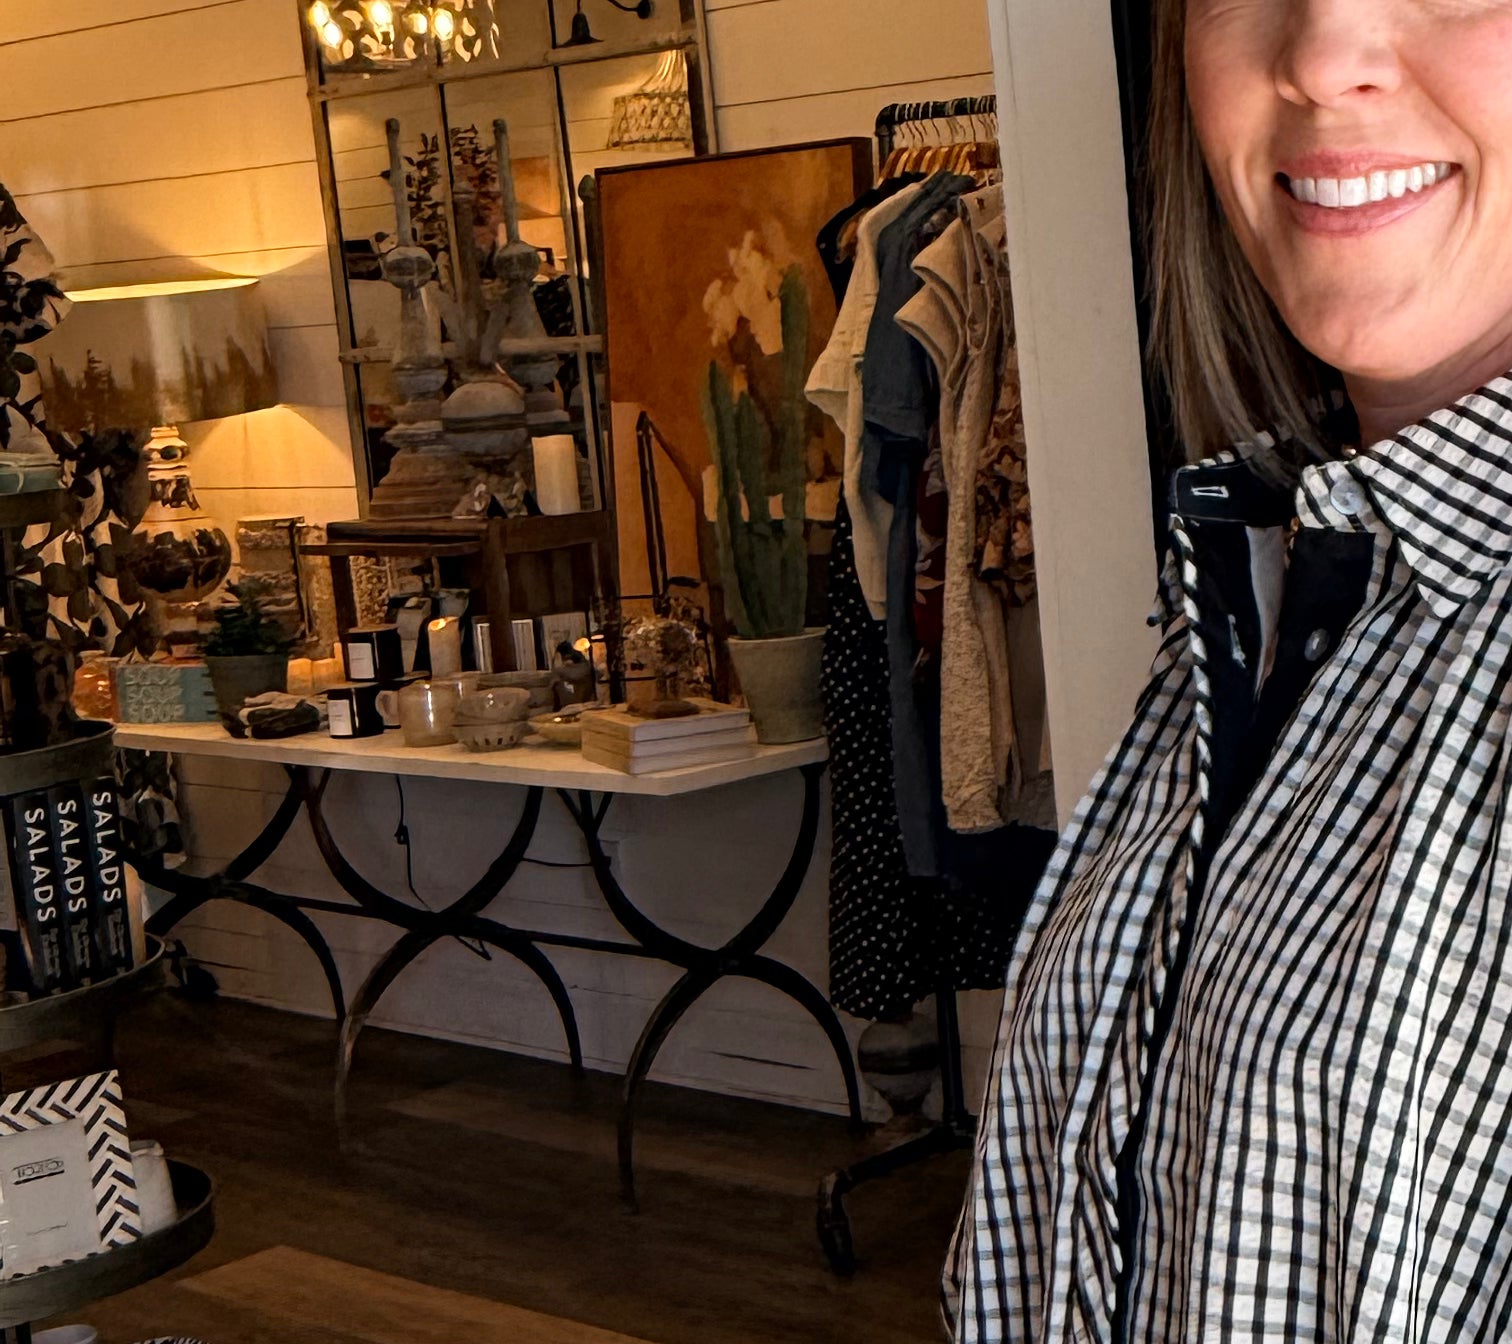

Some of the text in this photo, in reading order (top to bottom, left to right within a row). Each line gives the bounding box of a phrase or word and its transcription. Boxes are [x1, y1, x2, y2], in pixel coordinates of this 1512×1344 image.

[24, 807, 57, 923] SALADS
[58, 799, 88, 913] SALADS
[93, 791, 122, 903] SALADS
